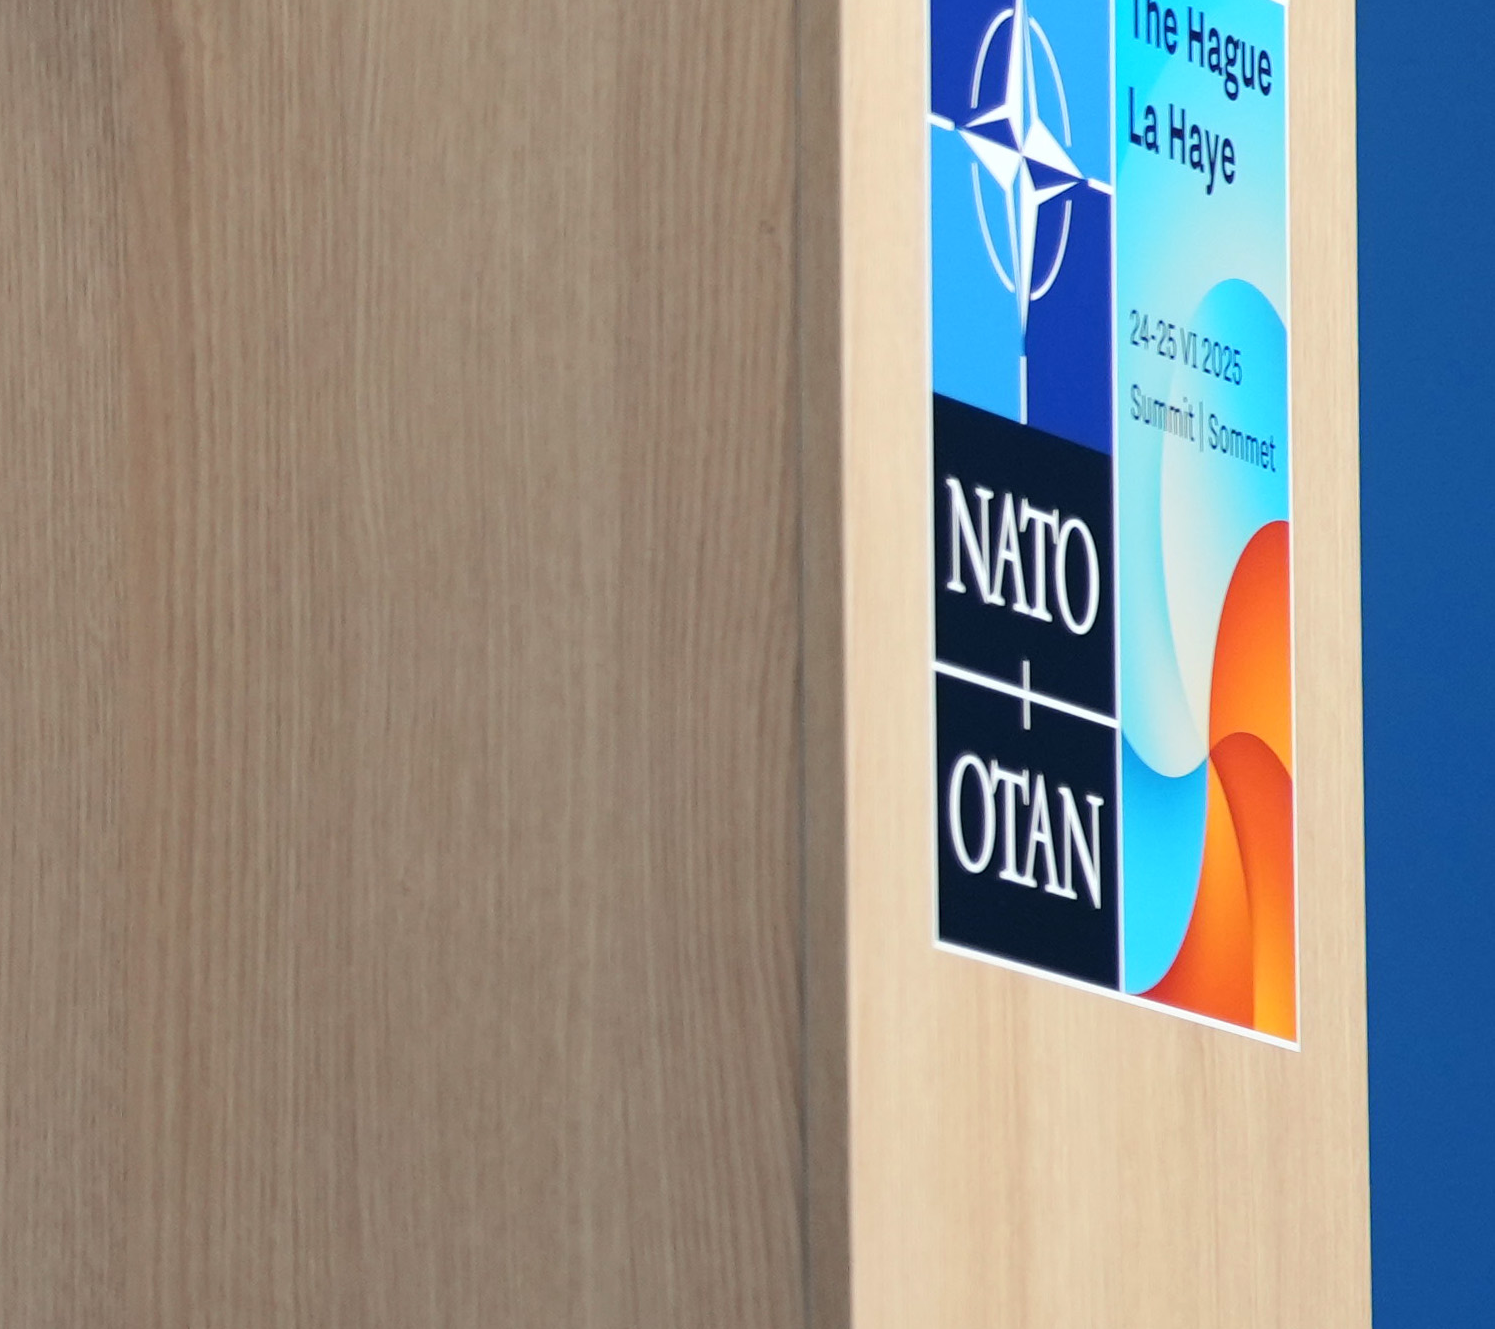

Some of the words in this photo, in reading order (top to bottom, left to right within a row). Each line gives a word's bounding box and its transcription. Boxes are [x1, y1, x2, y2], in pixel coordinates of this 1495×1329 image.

[1187, 6, 1272, 101] Hague
[1128, 86, 1159, 154] La
[1169, 103, 1236, 196] Haye
[1130, 309, 1177, 360] 24-25
[1180, 327, 1198, 369] VI
[1202, 337, 1243, 386] 2025
[1130, 384, 1195, 442] Summit
[1208, 413, 1276, 473] Sommet
[945, 476, 1101, 636] NATO
[948, 753, 1104, 910] OTAN
